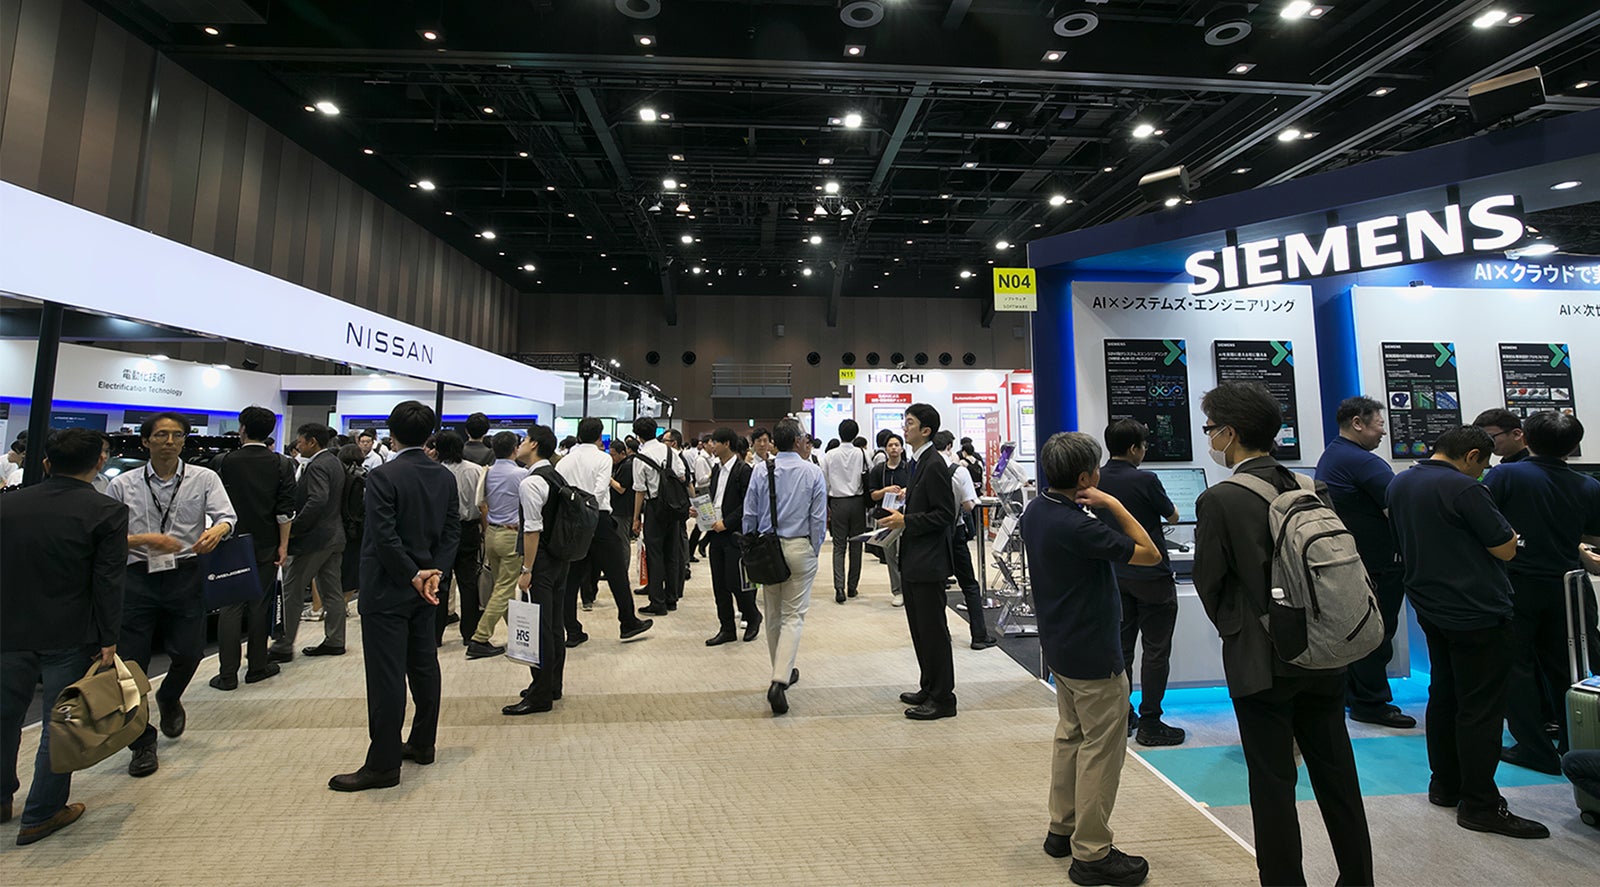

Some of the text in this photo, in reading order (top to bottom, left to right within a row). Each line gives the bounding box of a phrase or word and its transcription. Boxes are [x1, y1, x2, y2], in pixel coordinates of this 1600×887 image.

[1184, 194, 1524, 296] SIEMENS
[998, 273, 1031, 289] N04
[1092, 296, 1295, 313] AI×システムズ・エンジニアリング
[346, 321, 434, 364] NISSAN
[868, 374, 924, 384] HITACHI
[97, 380, 183, 397] Electrification Technology
[516, 629, 530, 642] HRS
